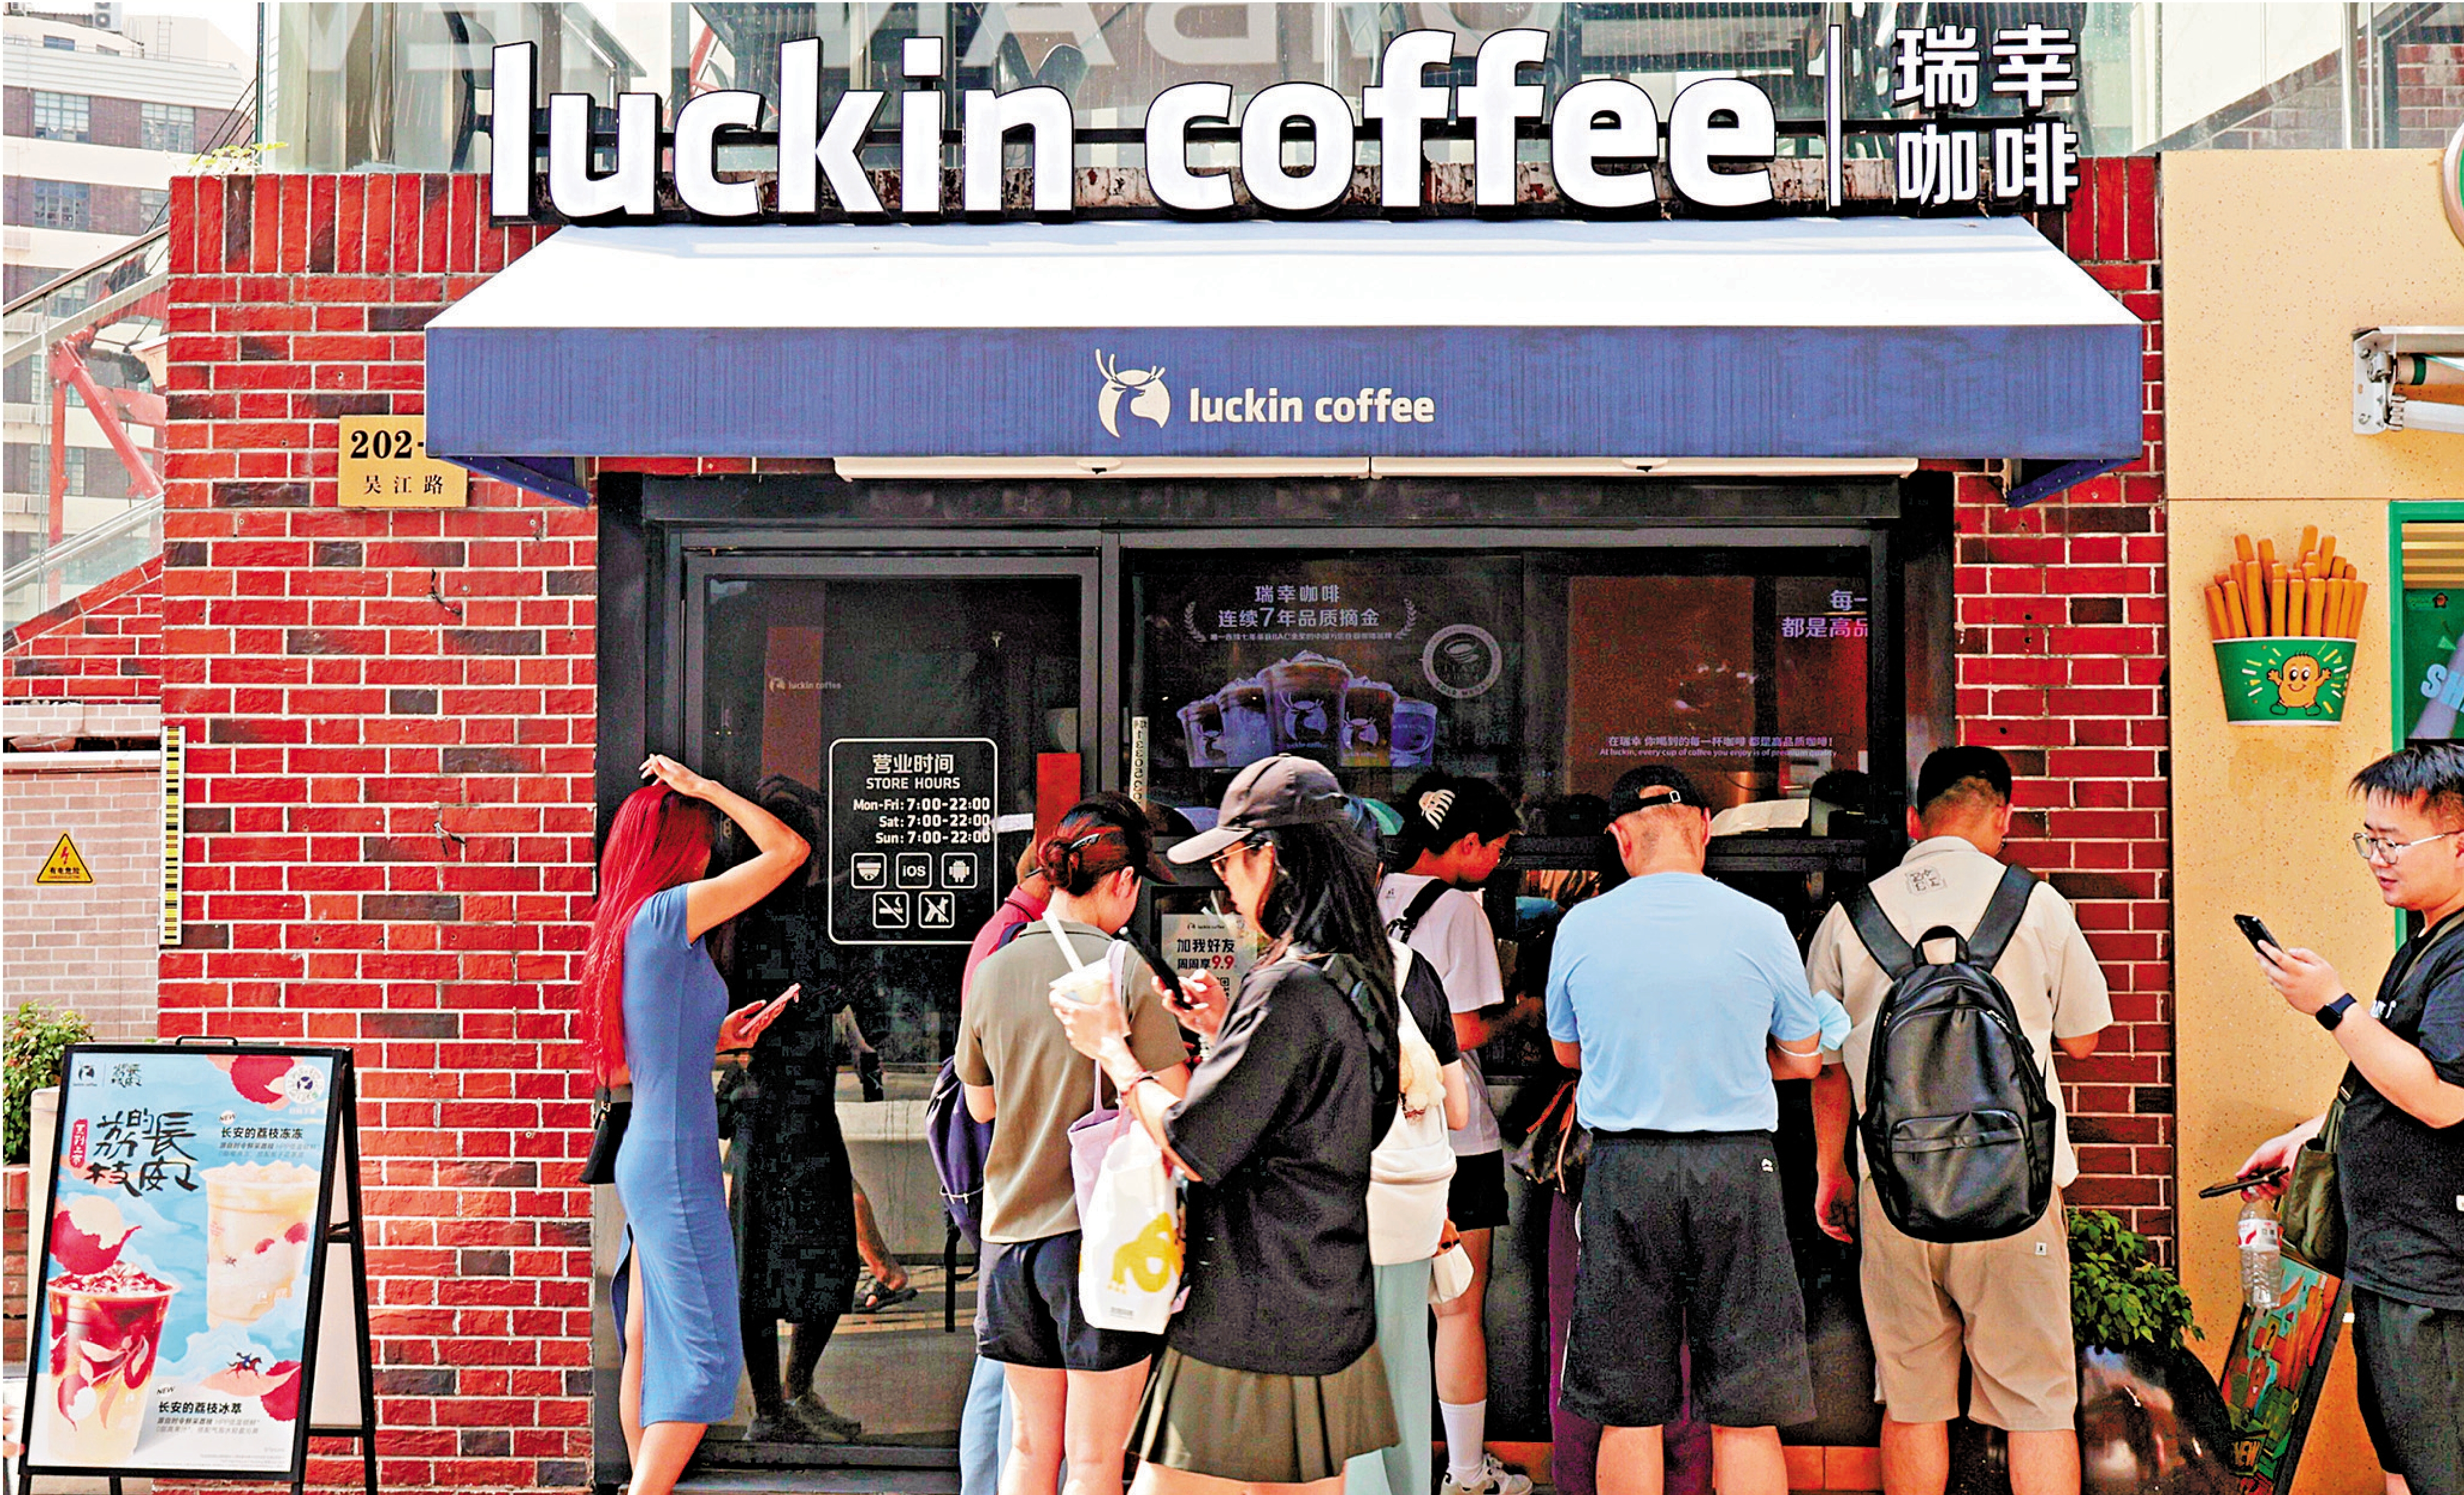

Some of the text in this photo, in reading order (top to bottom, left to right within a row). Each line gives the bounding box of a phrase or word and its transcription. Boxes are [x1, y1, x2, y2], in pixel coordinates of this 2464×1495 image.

[1896, 24, 2077, 109] 瑞幸
[491, 28, 1776, 219] luckin coffee
[1898, 123, 2078, 206] 咖啡
[1190, 388, 1435, 422] luckin coffee
[364, 474, 443, 495] 吴江路
[1255, 584, 1340, 603] 瑞幸咖啡
[1218, 607, 1379, 628] 连续7年品质摘金
[2420, 663, 2464, 714] SH
[1638, 748, 1659, 757] every
[872, 754, 954, 774] 营业时间
[866, 777, 960, 790] STORE HOURS
[853, 797, 990, 811] Mon-Fri: 7:00-22:00
[879, 814, 990, 828] Sat: 7:00-22:00
[875, 831, 990, 844] Sun: 7:00-22:00
[903, 866, 926, 877] iOS
[1177, 938, 1235, 953] 加我好友
